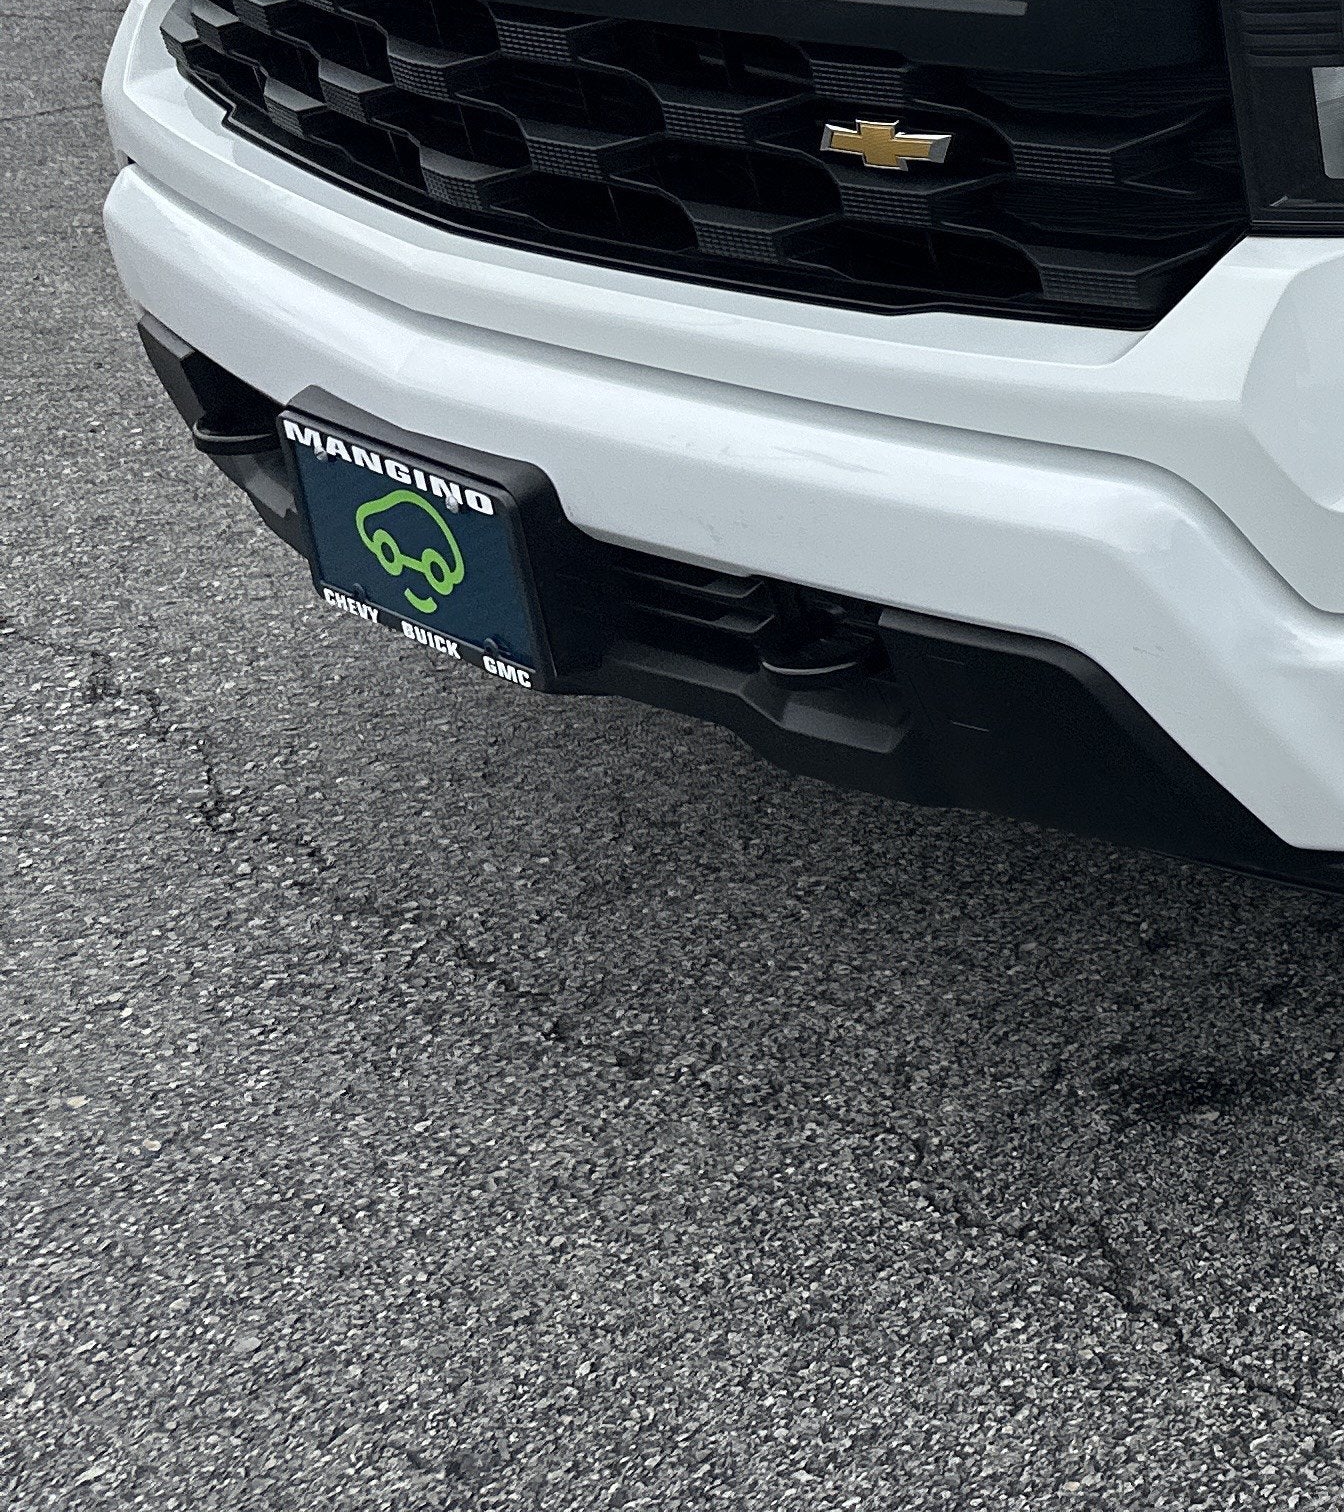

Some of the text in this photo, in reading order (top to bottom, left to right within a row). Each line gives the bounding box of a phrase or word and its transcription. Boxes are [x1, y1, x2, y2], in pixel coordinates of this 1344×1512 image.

[283, 419, 495, 516] MANGINO
[323, 587, 532, 689] CHEVY BUICK GMC
